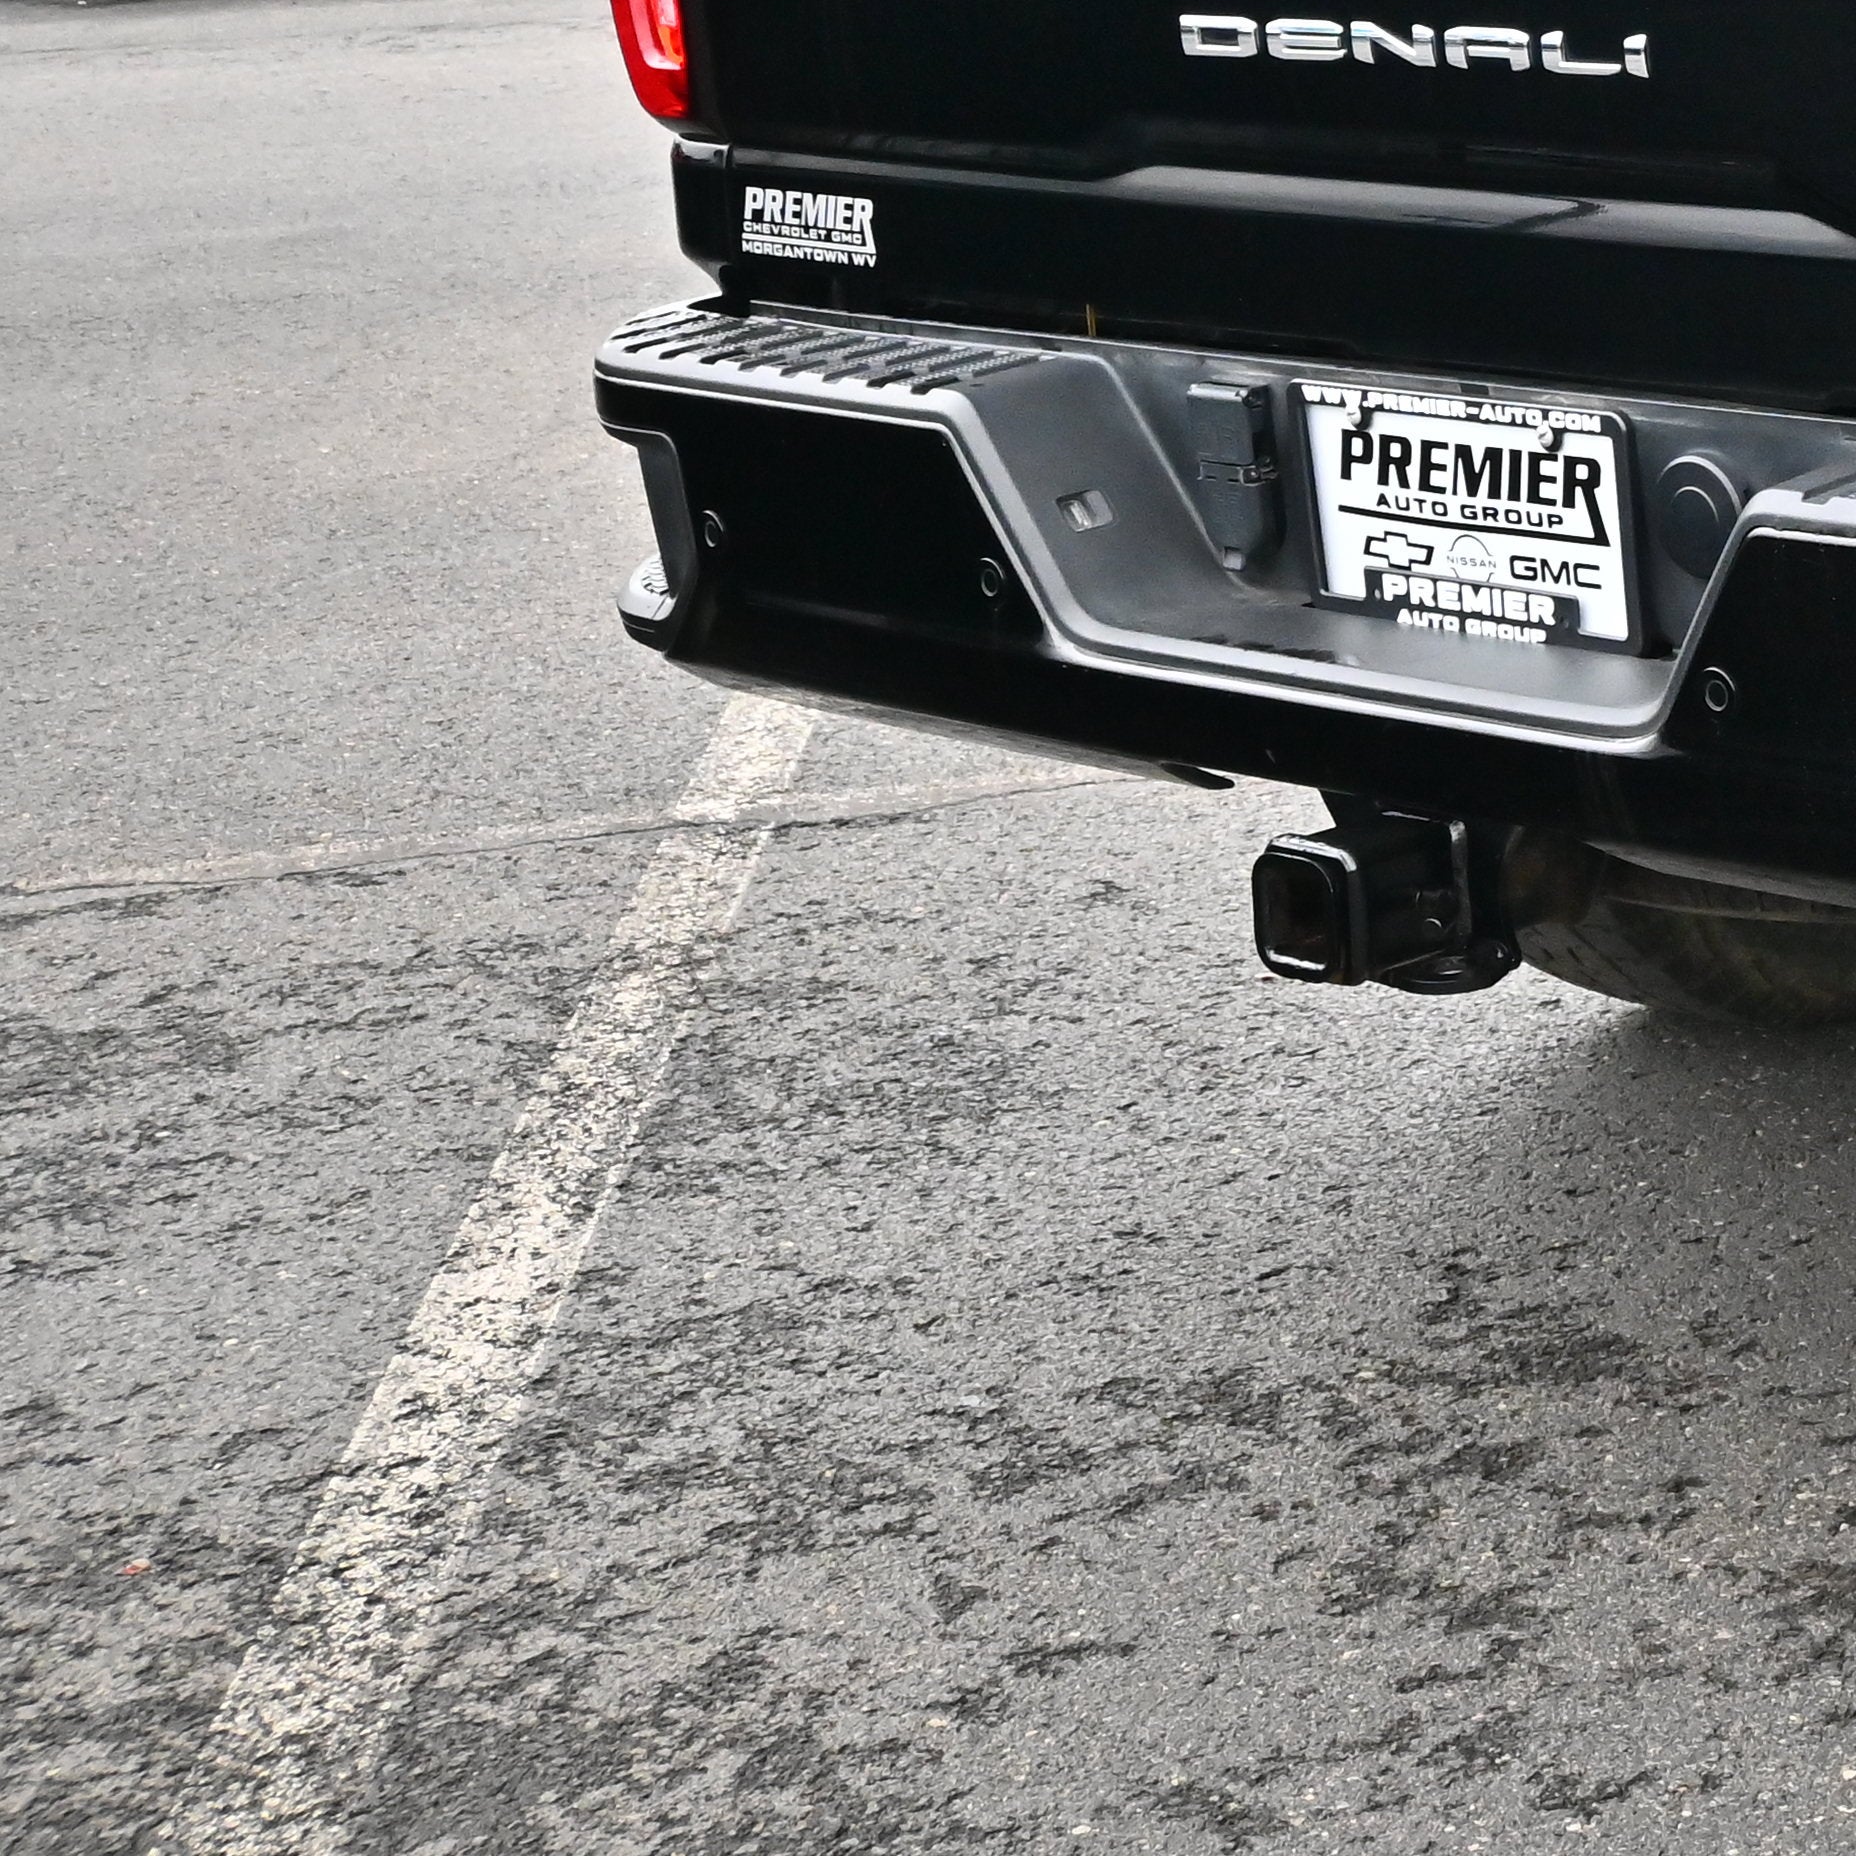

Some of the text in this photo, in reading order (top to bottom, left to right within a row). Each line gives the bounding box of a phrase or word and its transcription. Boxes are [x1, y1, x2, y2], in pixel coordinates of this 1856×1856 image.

[1180, 14, 1650, 79] DENALI
[743, 186, 876, 237] PREMIER
[743, 221, 862, 245] CHEVROLET GMC
[742, 240, 877, 268] MORGANTOWN WV
[1301, 384, 1602, 433] WWW.PREMIER-AUTO.COM
[1340, 429, 1604, 513] PREMIER
[1376, 493, 1564, 529] AUTO GROUP
[1446, 555, 1497, 569] NISSAN
[1510, 555, 1602, 590] GMC
[1381, 573, 1556, 626] PREMIER
[1396, 608, 1547, 644] AUTO GROUP
